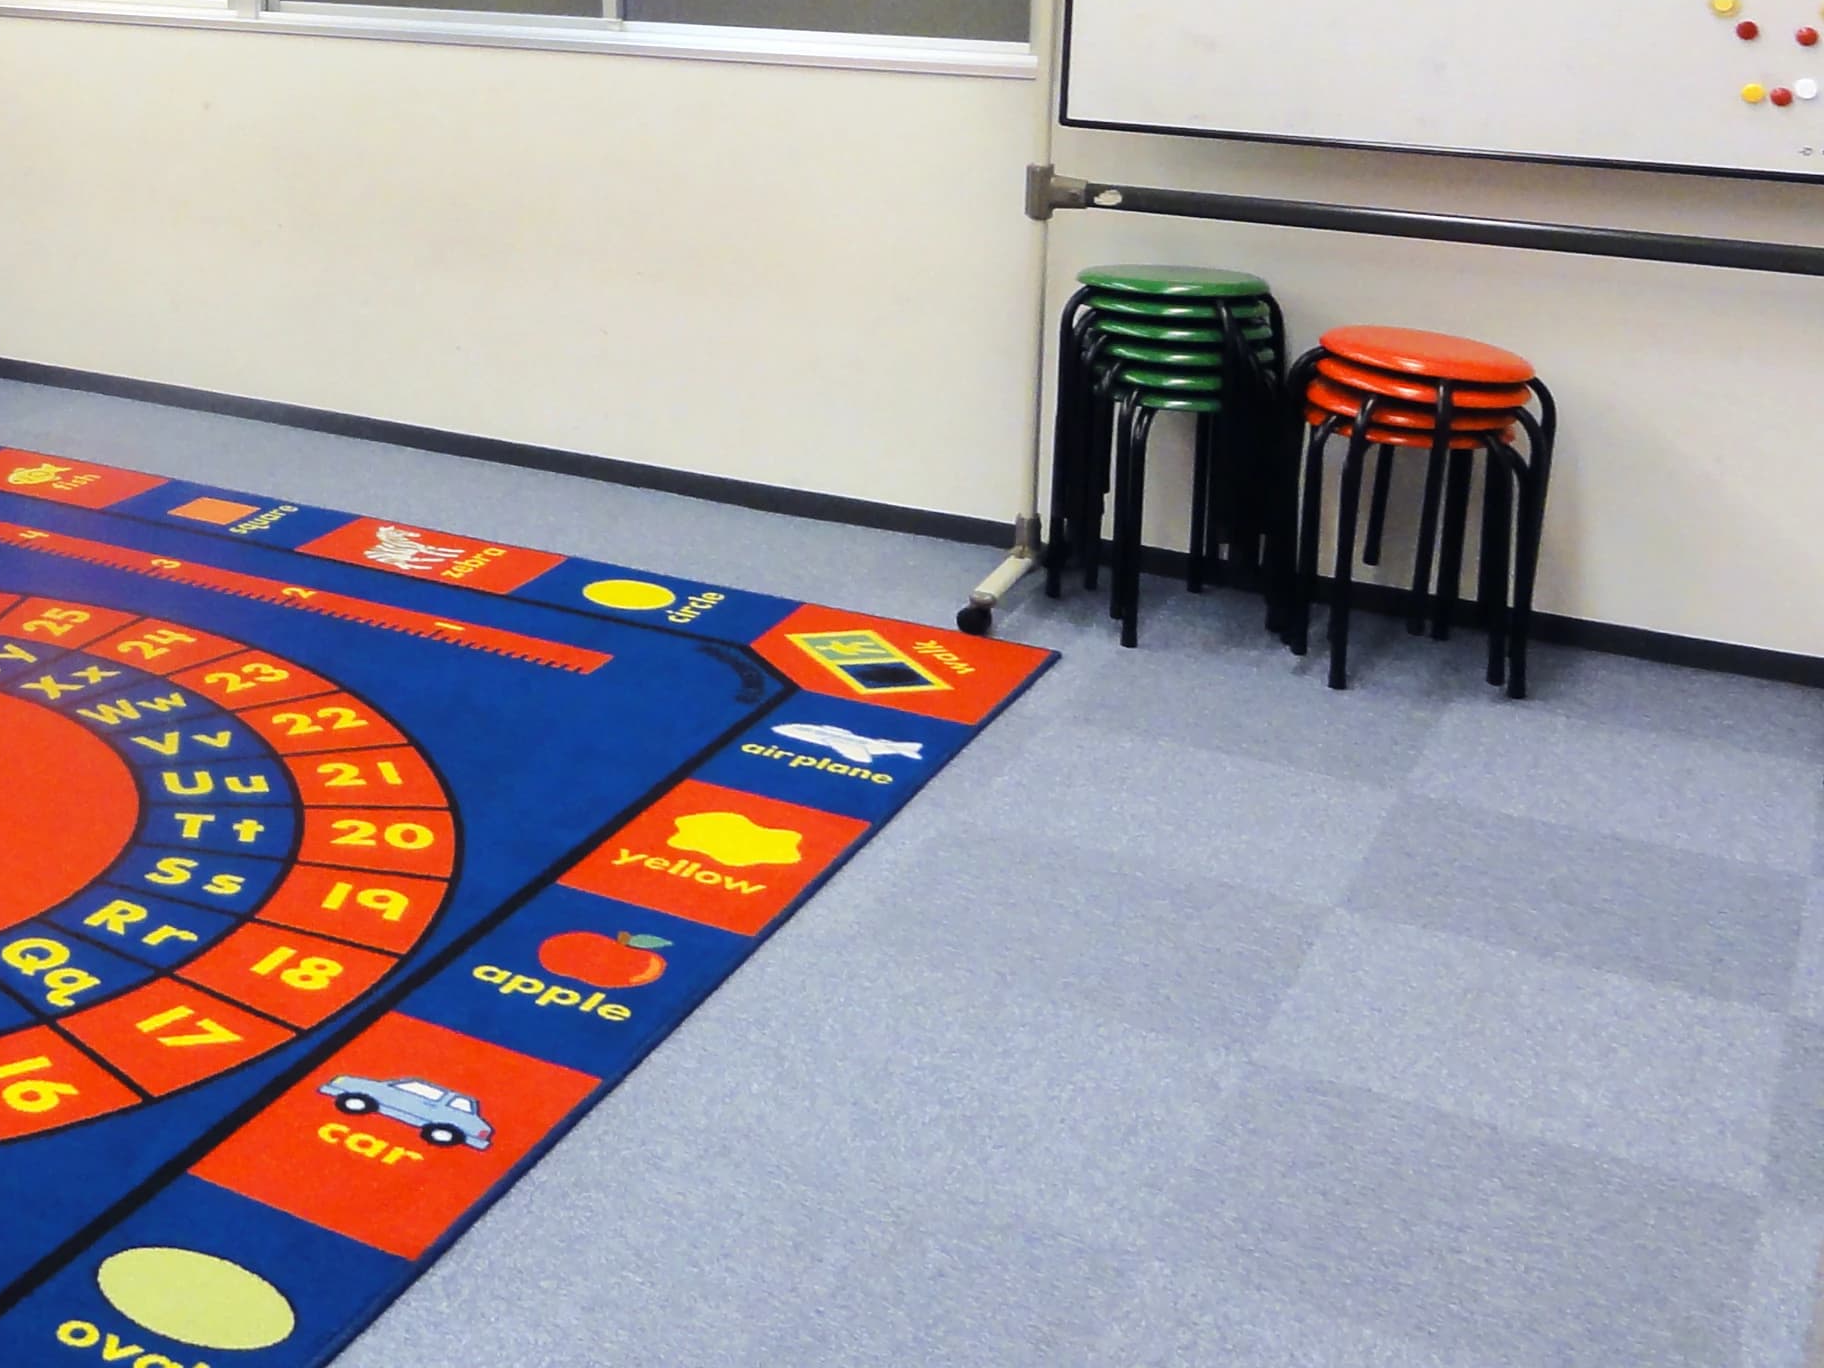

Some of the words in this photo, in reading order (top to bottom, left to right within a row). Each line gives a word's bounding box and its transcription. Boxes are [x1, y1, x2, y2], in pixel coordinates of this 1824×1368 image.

[52, 471, 101, 491] fish
[229, 503, 299, 535] square
[439, 546, 506, 579] zebra
[23, 608, 90, 636] 25
[667, 590, 726, 624] circle
[117, 629, 196, 659] 24
[915, 639, 976, 675] walk
[204, 663, 289, 693] 23
[272, 707, 368, 735] 22
[317, 762, 402, 786] 21
[741, 741, 894, 785] airplane
[331, 819, 434, 850] 20
[612, 847, 768, 895] yellow
[322, 882, 409, 921] 19
[250, 946, 343, 990] 18
[472, 964, 633, 1021] apple
[136, 1006, 243, 1046] 17
[317, 1121, 424, 1165] car
[56, 1320, 211, 1368] ova
